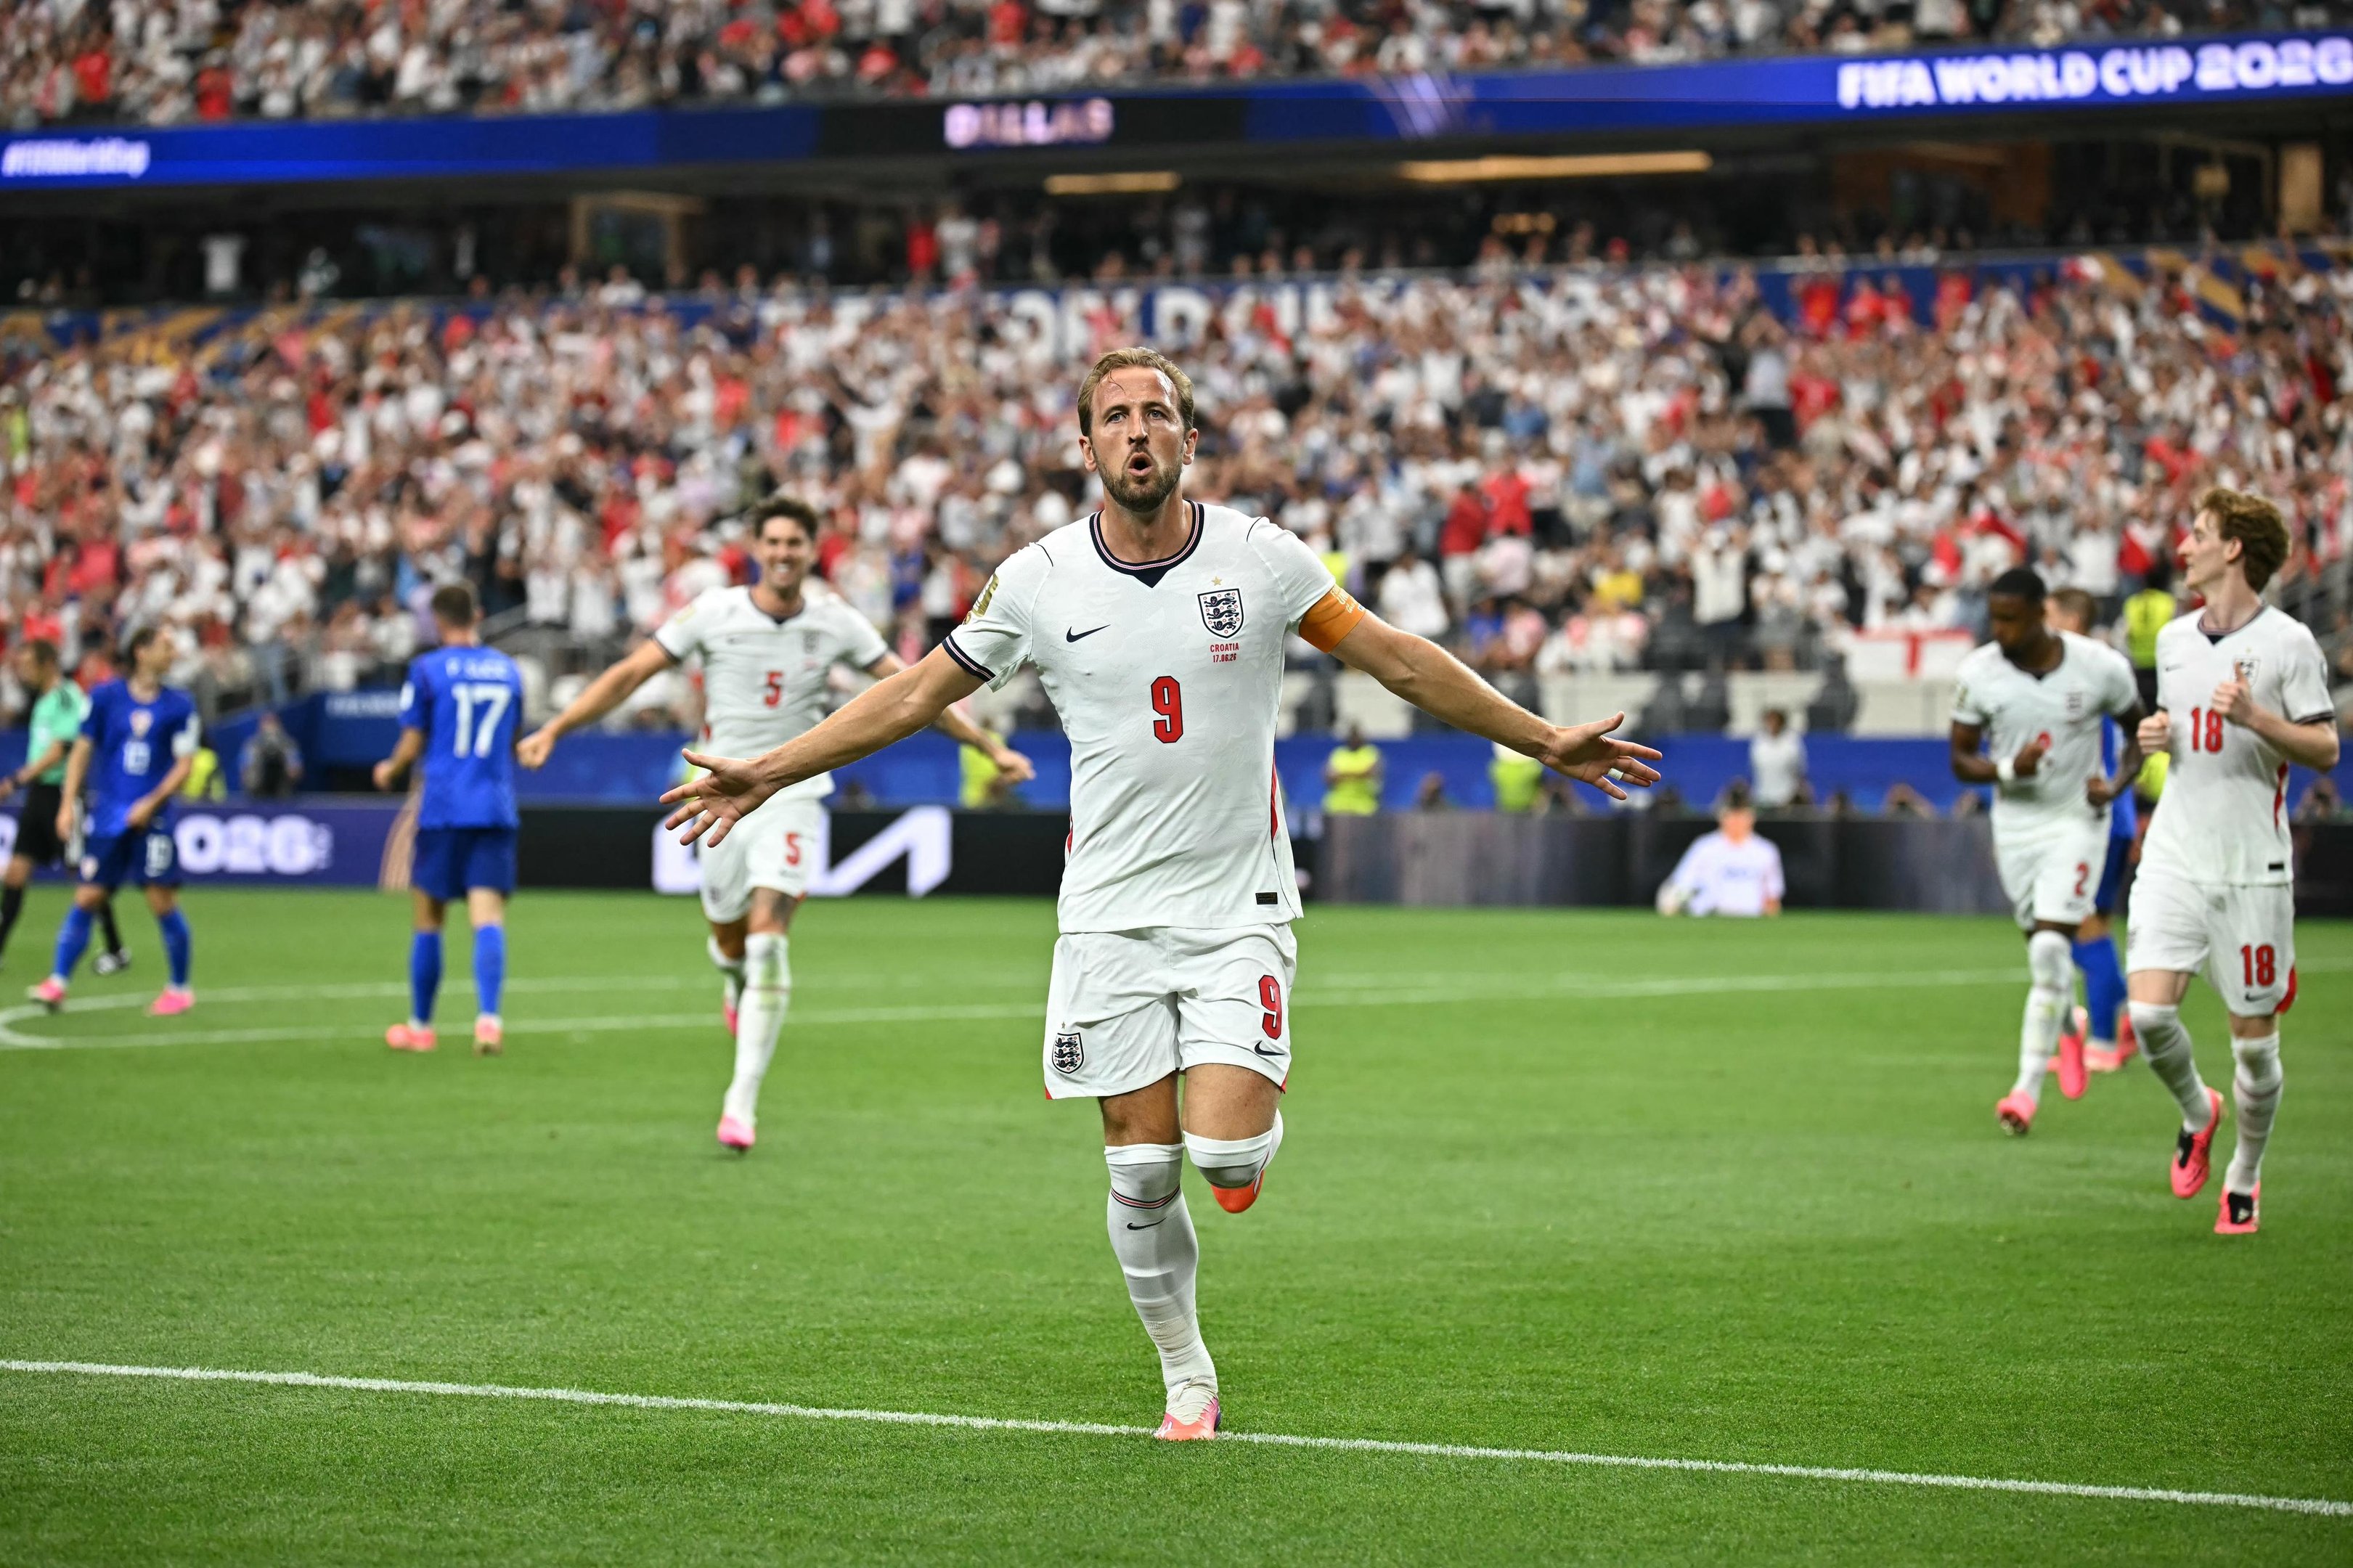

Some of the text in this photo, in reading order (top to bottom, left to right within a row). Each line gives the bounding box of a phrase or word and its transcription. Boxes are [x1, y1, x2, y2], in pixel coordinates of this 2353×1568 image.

[1838, 37, 2353, 108] FIFA WORLD CUP 2026
[1210, 642, 1239, 653] CROATIA
[1212, 653, 1237, 663] 17.06.26
[764, 671, 784, 708] 5
[1151, 675, 1183, 743] 9
[452, 682, 511, 758] 17
[2191, 707, 2224, 754] 18
[174, 813, 317, 875] 026
[785, 833, 801, 866] 5
[2074, 862, 2089, 897] 2
[2240, 944, 2275, 987] 18
[1258, 975, 1282, 1040] 9
